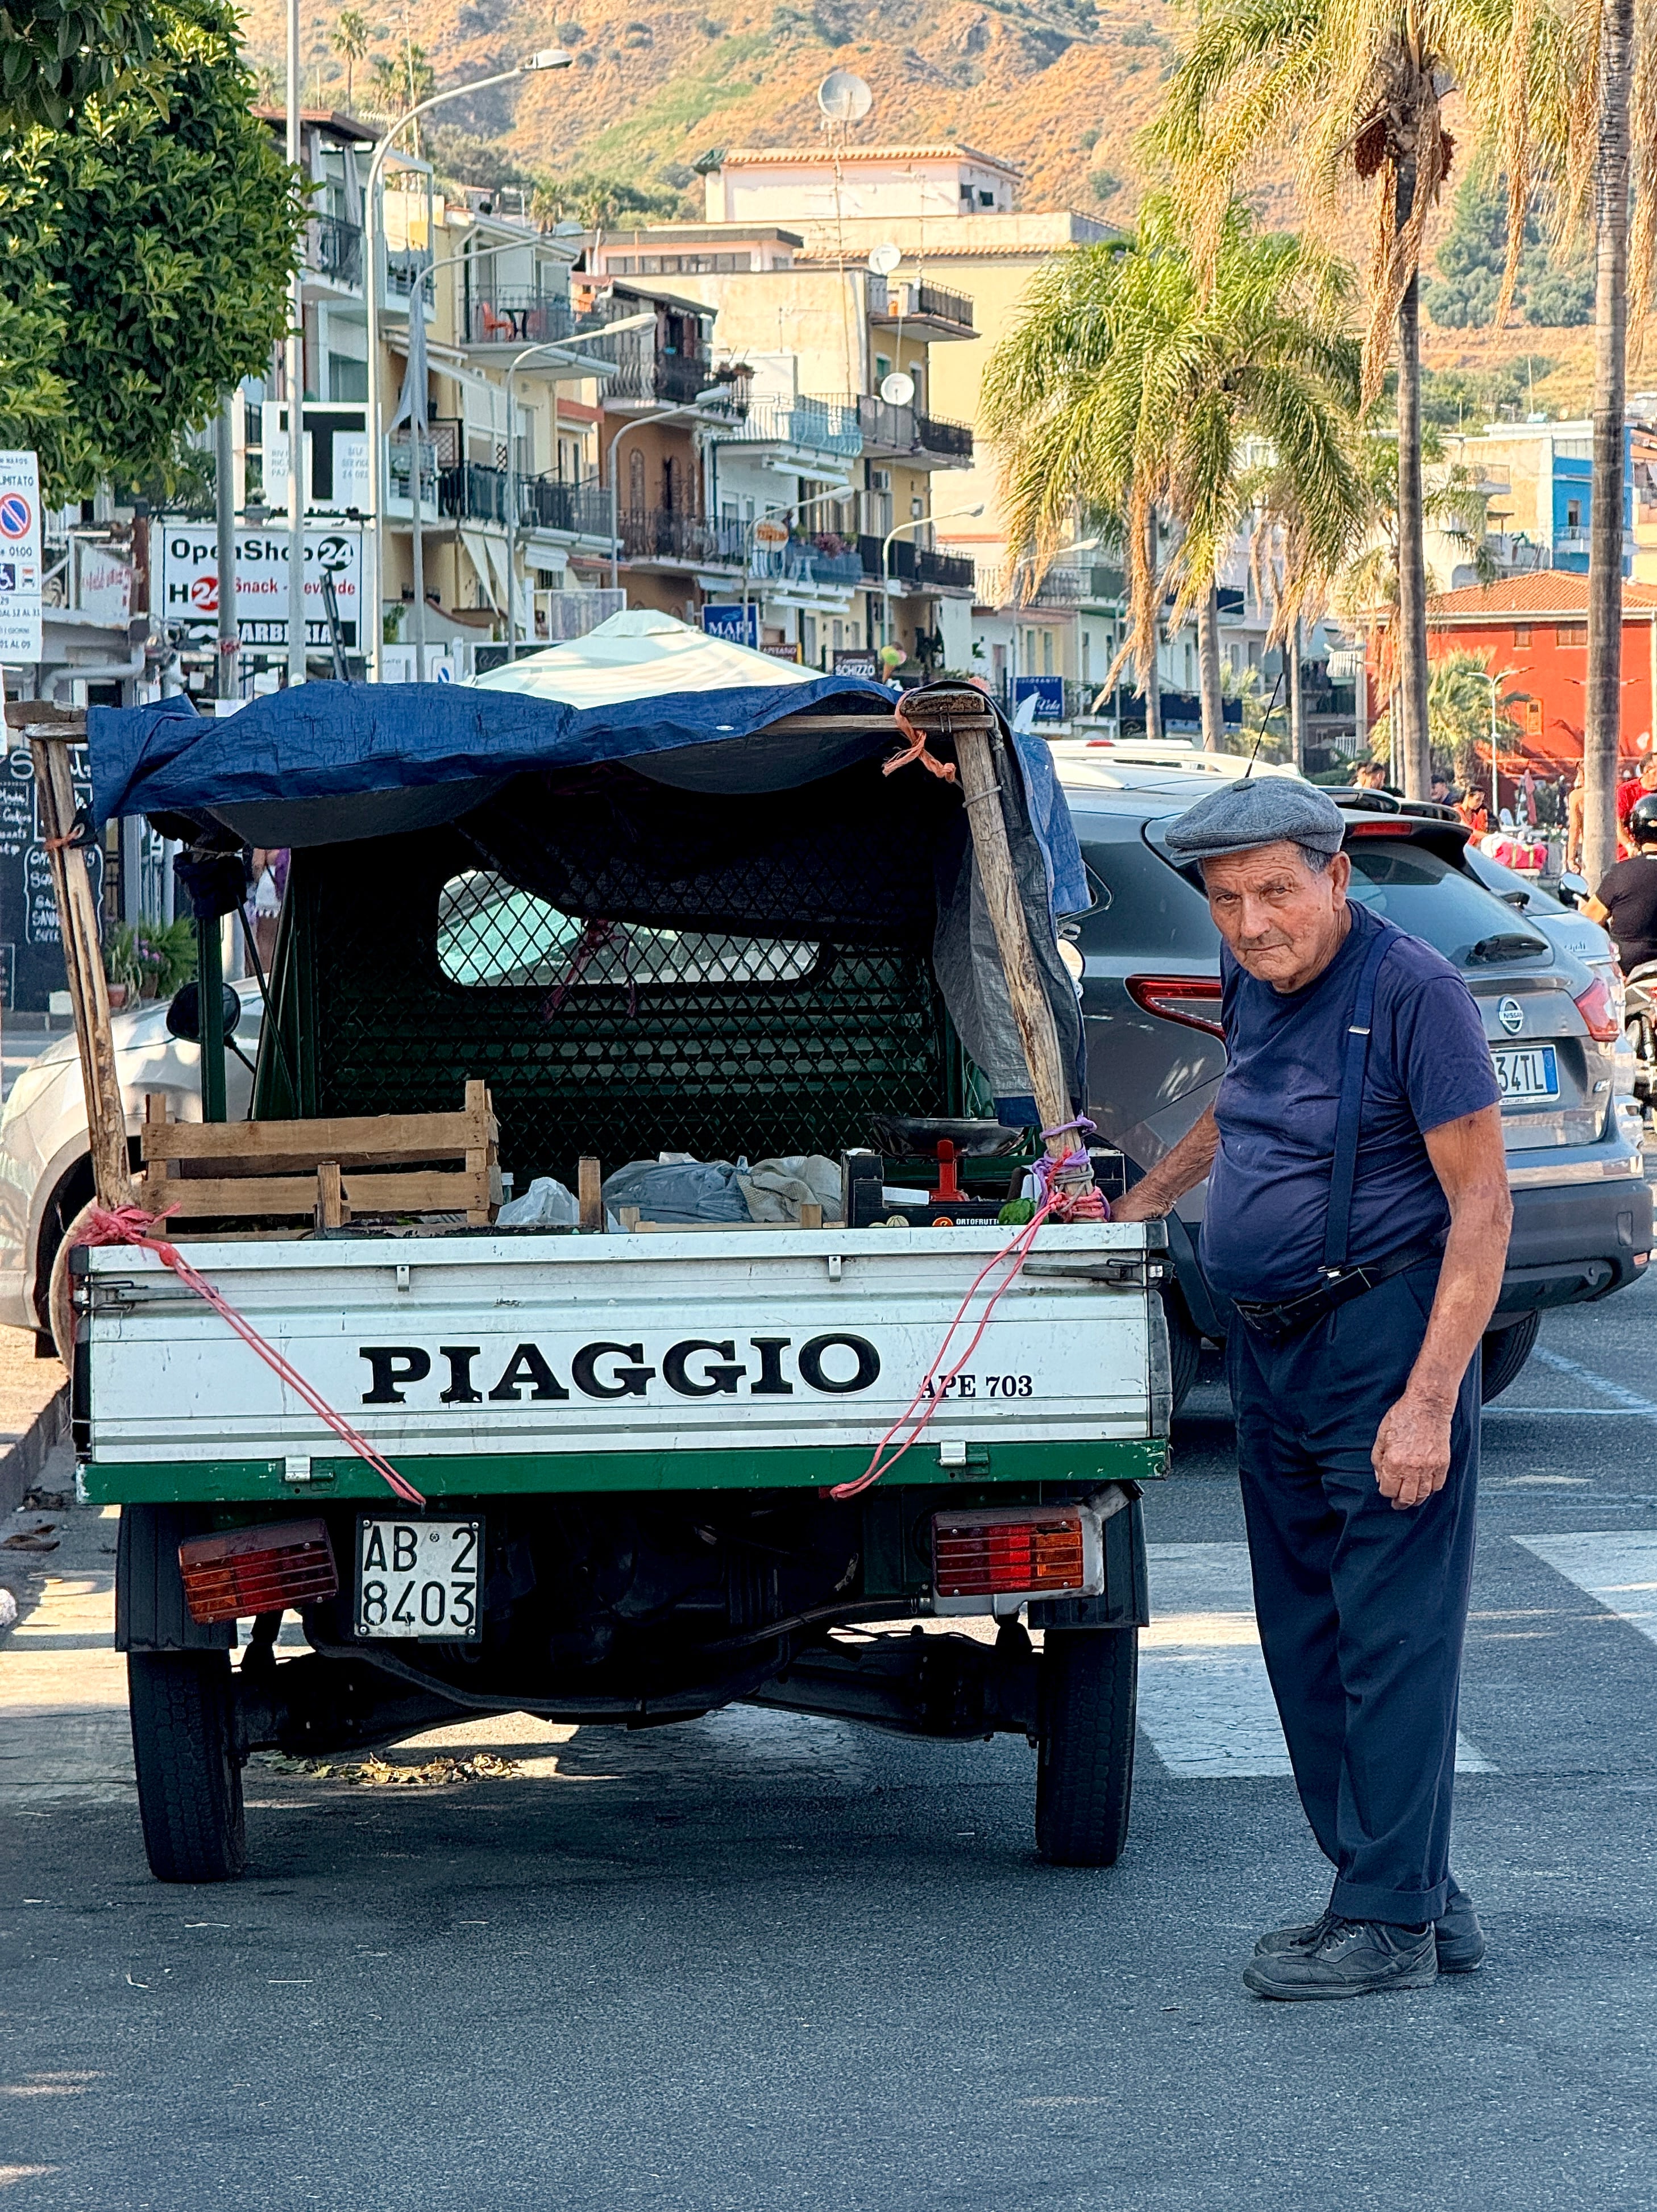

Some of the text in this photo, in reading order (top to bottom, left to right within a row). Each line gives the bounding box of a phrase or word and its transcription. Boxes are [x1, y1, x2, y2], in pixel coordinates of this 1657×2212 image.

[359, 1332, 882, 1404] PIAGGIO
[919, 1375, 1033, 1398] APE 703
[364, 1525, 476, 1573] AB 2
[363, 1580, 476, 1627] 8403
